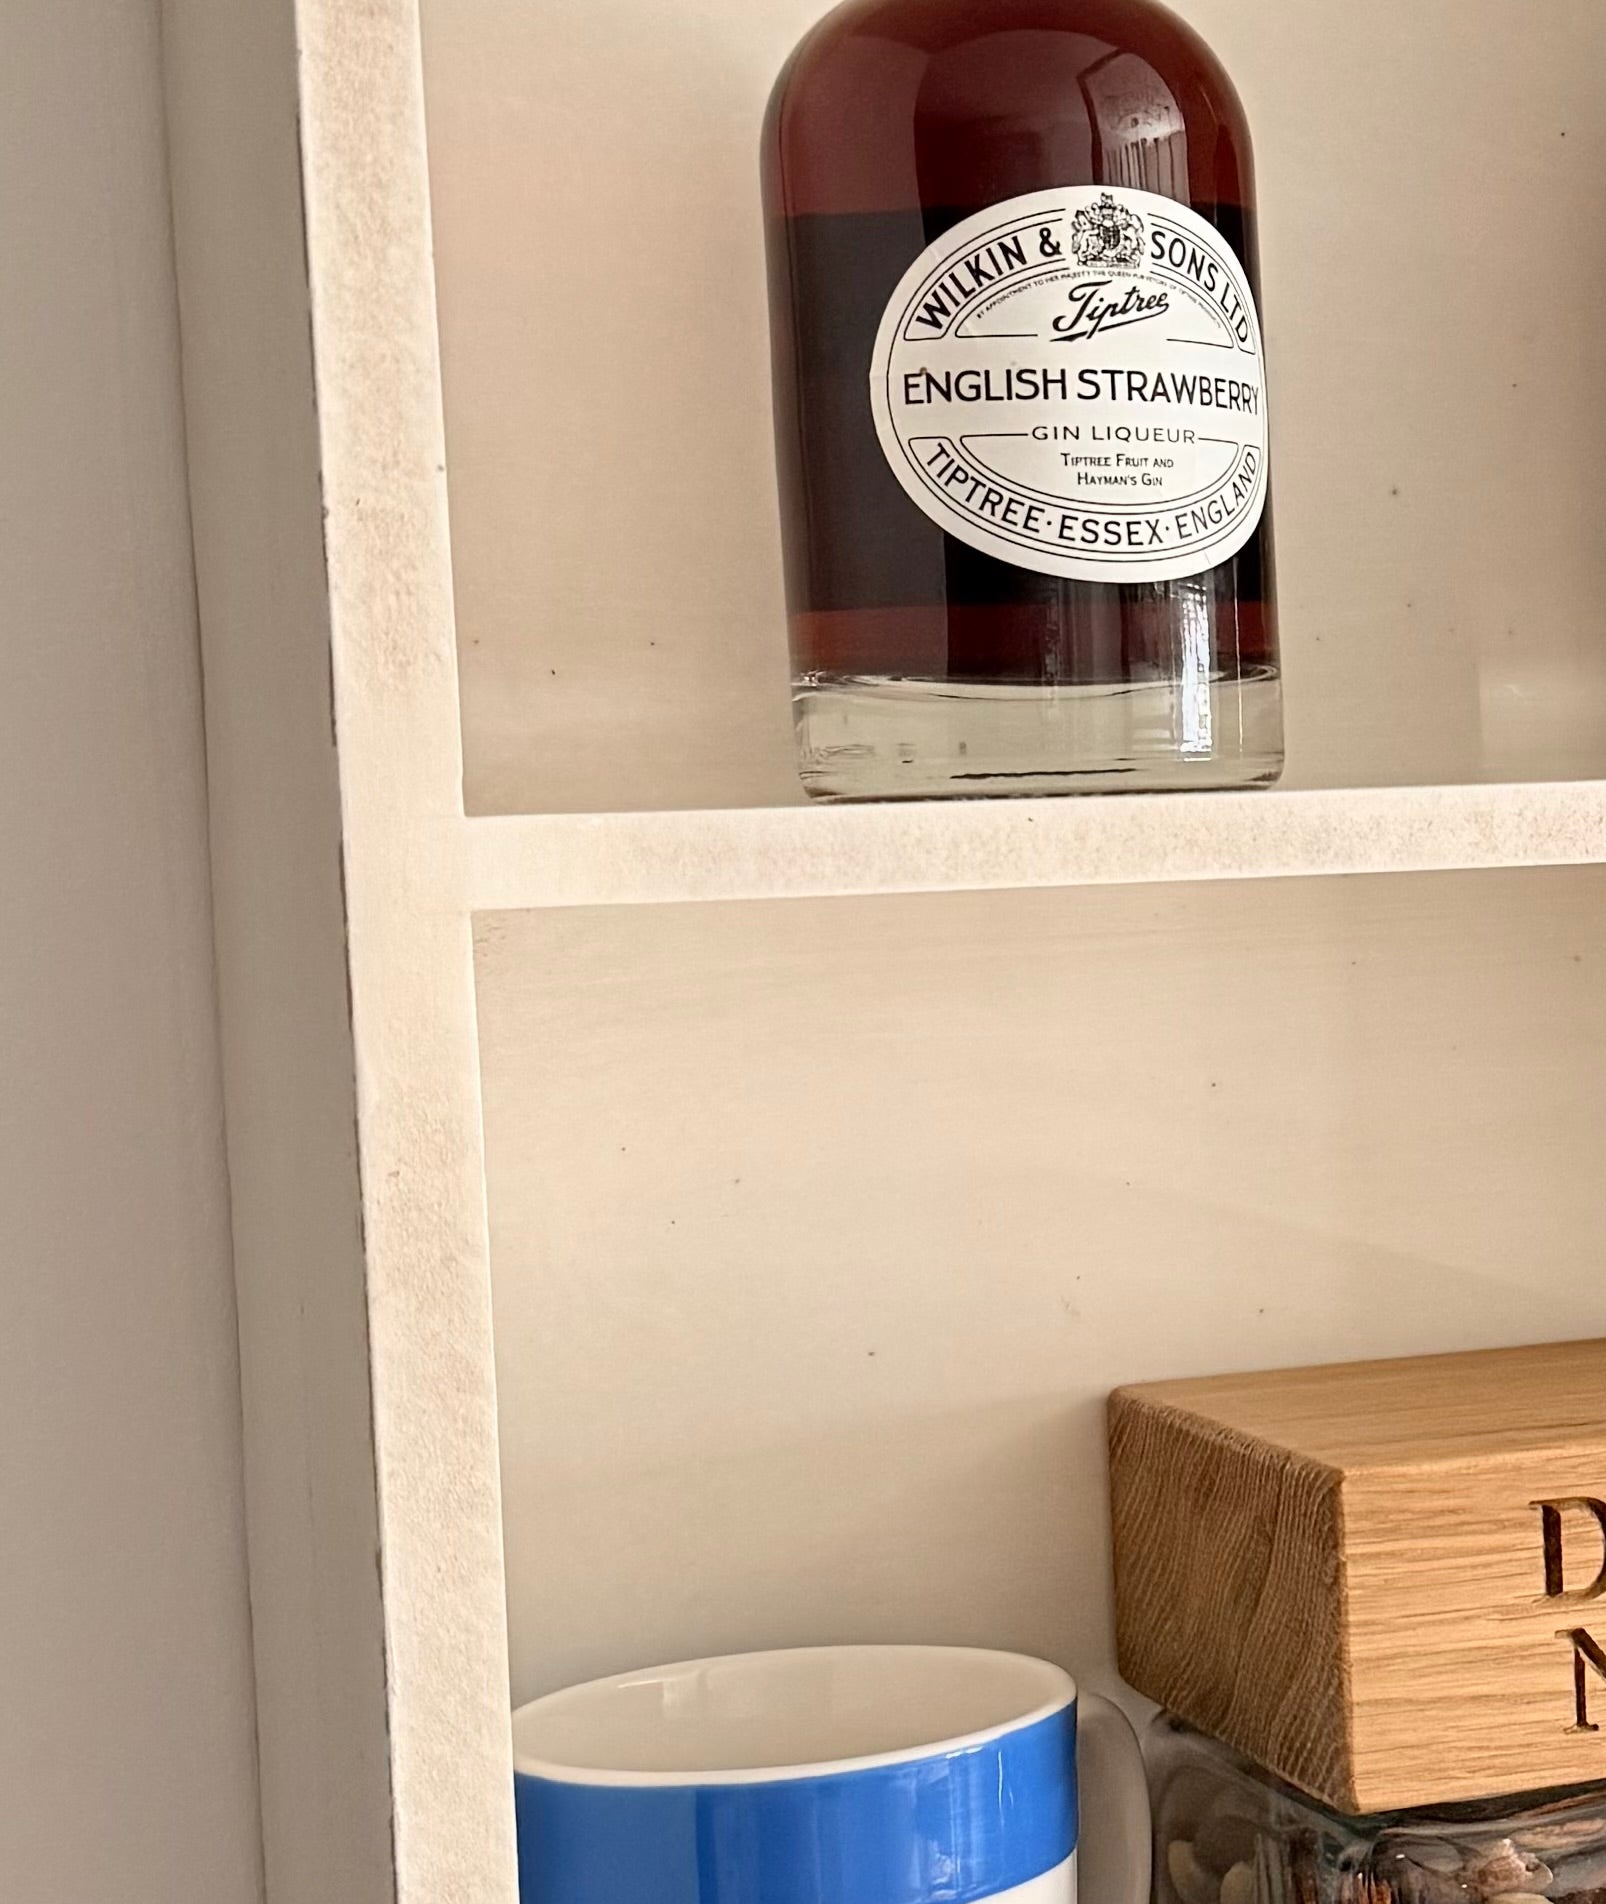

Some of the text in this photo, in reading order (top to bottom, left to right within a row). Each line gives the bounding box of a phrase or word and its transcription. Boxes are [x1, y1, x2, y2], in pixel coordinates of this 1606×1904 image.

[915, 235, 1029, 331] WILKIN
[1038, 226, 1061, 258] &
[1149, 230, 1219, 290] SONS
[1219, 281, 1251, 345] LTD
[1049, 279, 1170, 343] Tiptree
[903, 368, 1260, 416] ENGLISH STRAWBERRY
[1031, 425, 1196, 445] GIN LIQUEUR
[926, 442, 1257, 547] TIPTREE ESSEX ENGLAND
